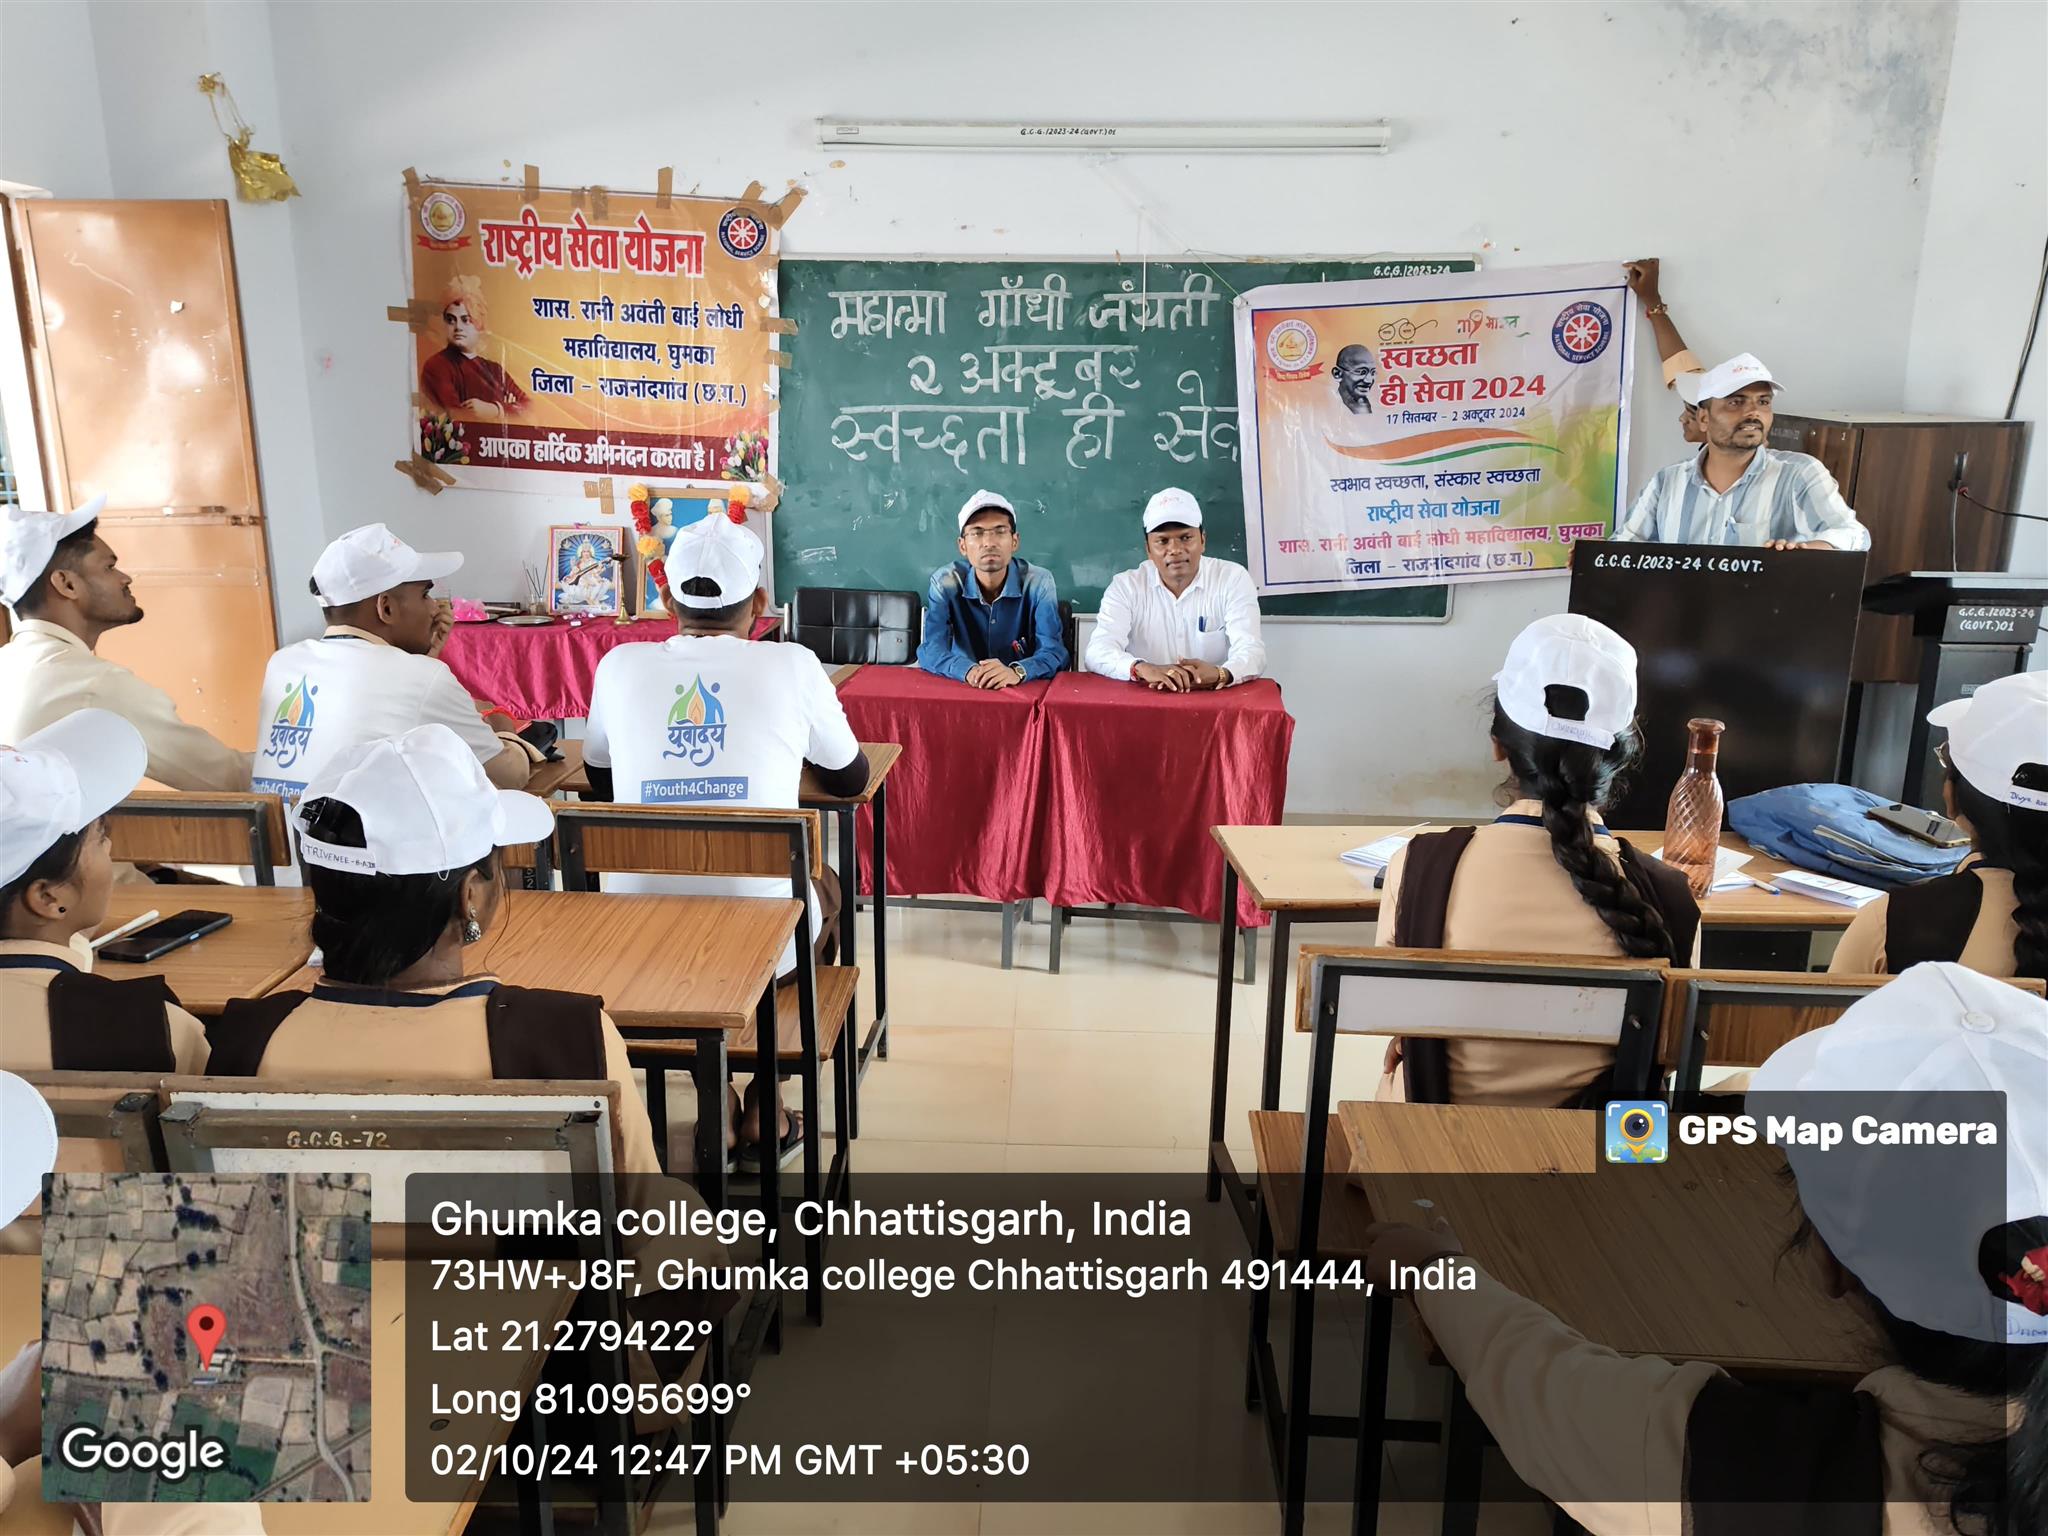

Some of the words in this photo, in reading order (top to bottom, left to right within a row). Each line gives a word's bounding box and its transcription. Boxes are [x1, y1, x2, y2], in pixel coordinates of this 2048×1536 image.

[480, 207, 563, 275] राष्ट्रीय
[566, 212, 620, 270] सेवा
[623, 215, 705, 275] योजना
[532, 297, 576, 320] शास.
[579, 295, 614, 322] रानी
[620, 298, 666, 325] अवंती
[671, 301, 700, 328] बाई
[704, 302, 744, 329] लोधी
[828, 290, 948, 340] महात्मा
[563, 334, 662, 365] महाविद्यालय,
[667, 343, 716, 369] घुमका
[1380, 343, 1480, 370] स्वच्छता
[531, 368, 574, 394] जिला
[599, 376, 688, 401] राजनांदगांव
[959, 344, 1143, 401] अक्टूबर
[1379, 374, 1409, 406] ही
[1412, 373, 1467, 403] सेवा
[1471, 374, 1547, 401] 2024
[1386, 414, 1399, 425] 17
[1451, 410, 1458, 422] 2
[1499, 406, 1526, 419] 2024
[830, 404, 1031, 475] स्वच्छता
[1061, 391, 1126, 470] ही
[478, 436, 531, 461] आपका
[532, 432, 583, 465] हार्दिक
[583, 435, 650, 468] अभिनंदन
[649, 447, 692, 471] करता
[692, 441, 706, 472] है
[1330, 476, 1372, 493] स्वभाव
[1374, 474, 1430, 491] स्वच्छता,
[1434, 469, 1482, 488] संस्कार
[1486, 467, 1542, 485] स्वच्छता
[1366, 499, 1415, 525] राष्ट्रीय
[1417, 498, 1448, 520] सेवा
[1451, 496, 1501, 518] योजना
[1318, 533, 1349, 552] रानी
[1353, 530, 1393, 551] अवंती
[1396, 530, 1422, 549] बाई
[1464, 525, 1552, 546] महाविद्यालय,
[1557, 522, 1605, 546] घुमका
[1345, 557, 1382, 575] जिला
[1402, 552, 1481, 572] राजनांदगांव
[1594, 553, 1702, 571] G.C.G./2023-24
[644, 780, 745, 798] #Youth4Change
